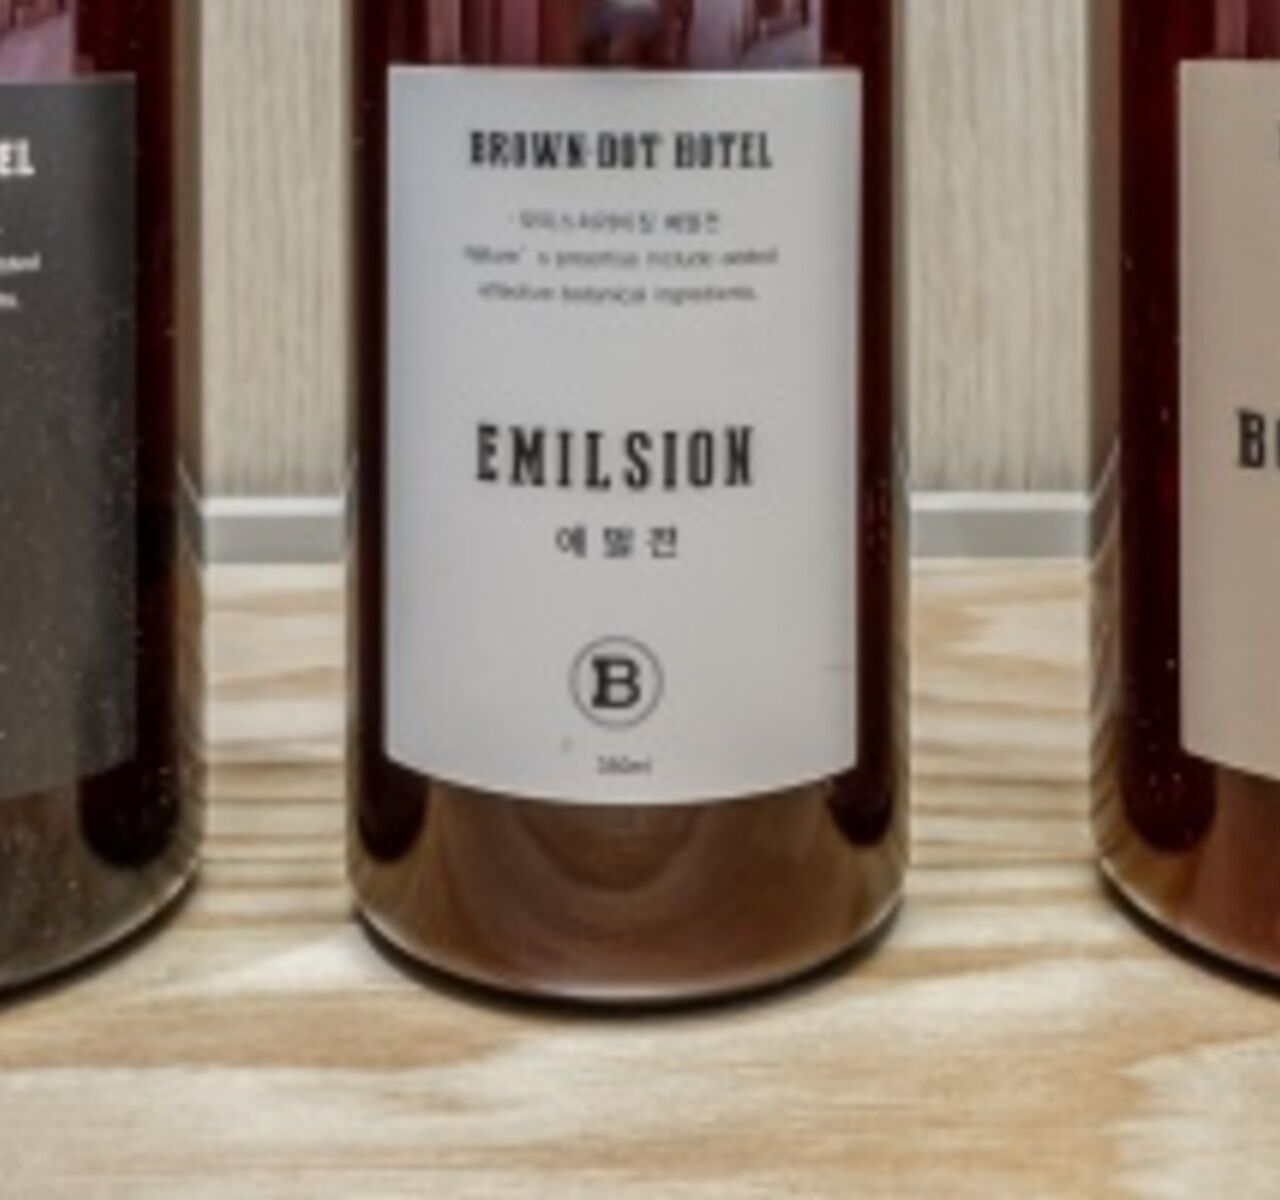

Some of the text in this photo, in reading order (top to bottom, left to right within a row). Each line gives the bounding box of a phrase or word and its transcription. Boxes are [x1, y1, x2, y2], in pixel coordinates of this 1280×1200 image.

[674, 130, 773, 169] HOTEL
[477, 422, 754, 492] EMILSION
[591, 655, 642, 710] B
